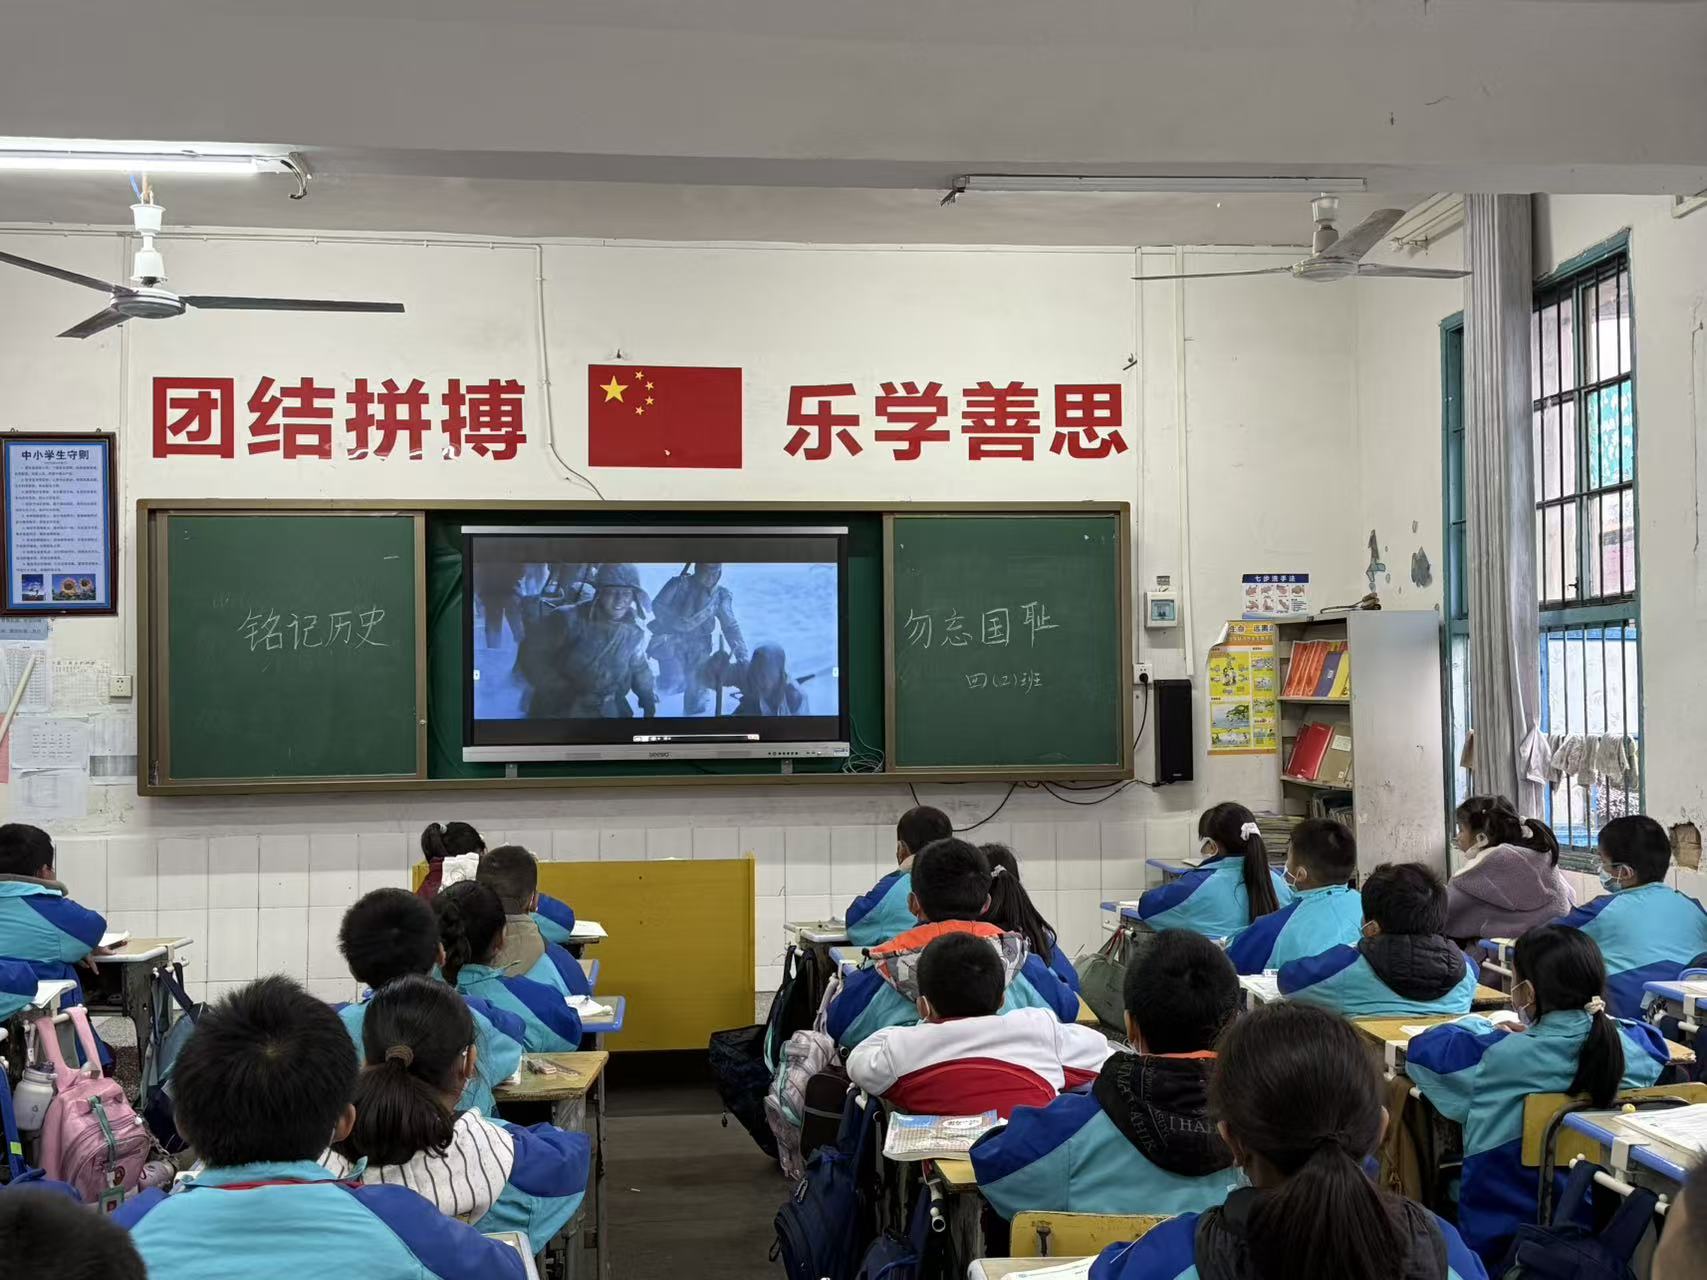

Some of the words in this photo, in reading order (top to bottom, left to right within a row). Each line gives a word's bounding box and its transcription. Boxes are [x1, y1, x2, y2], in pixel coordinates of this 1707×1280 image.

[152, 376, 527, 461] 团结拼搏
[783, 381, 1129, 461] 乐学善思
[21, 449, 89, 460] 中小学生守则
[237, 604, 390, 651] 铭记历史
[904, 601, 1060, 648] 勿忘国耻
